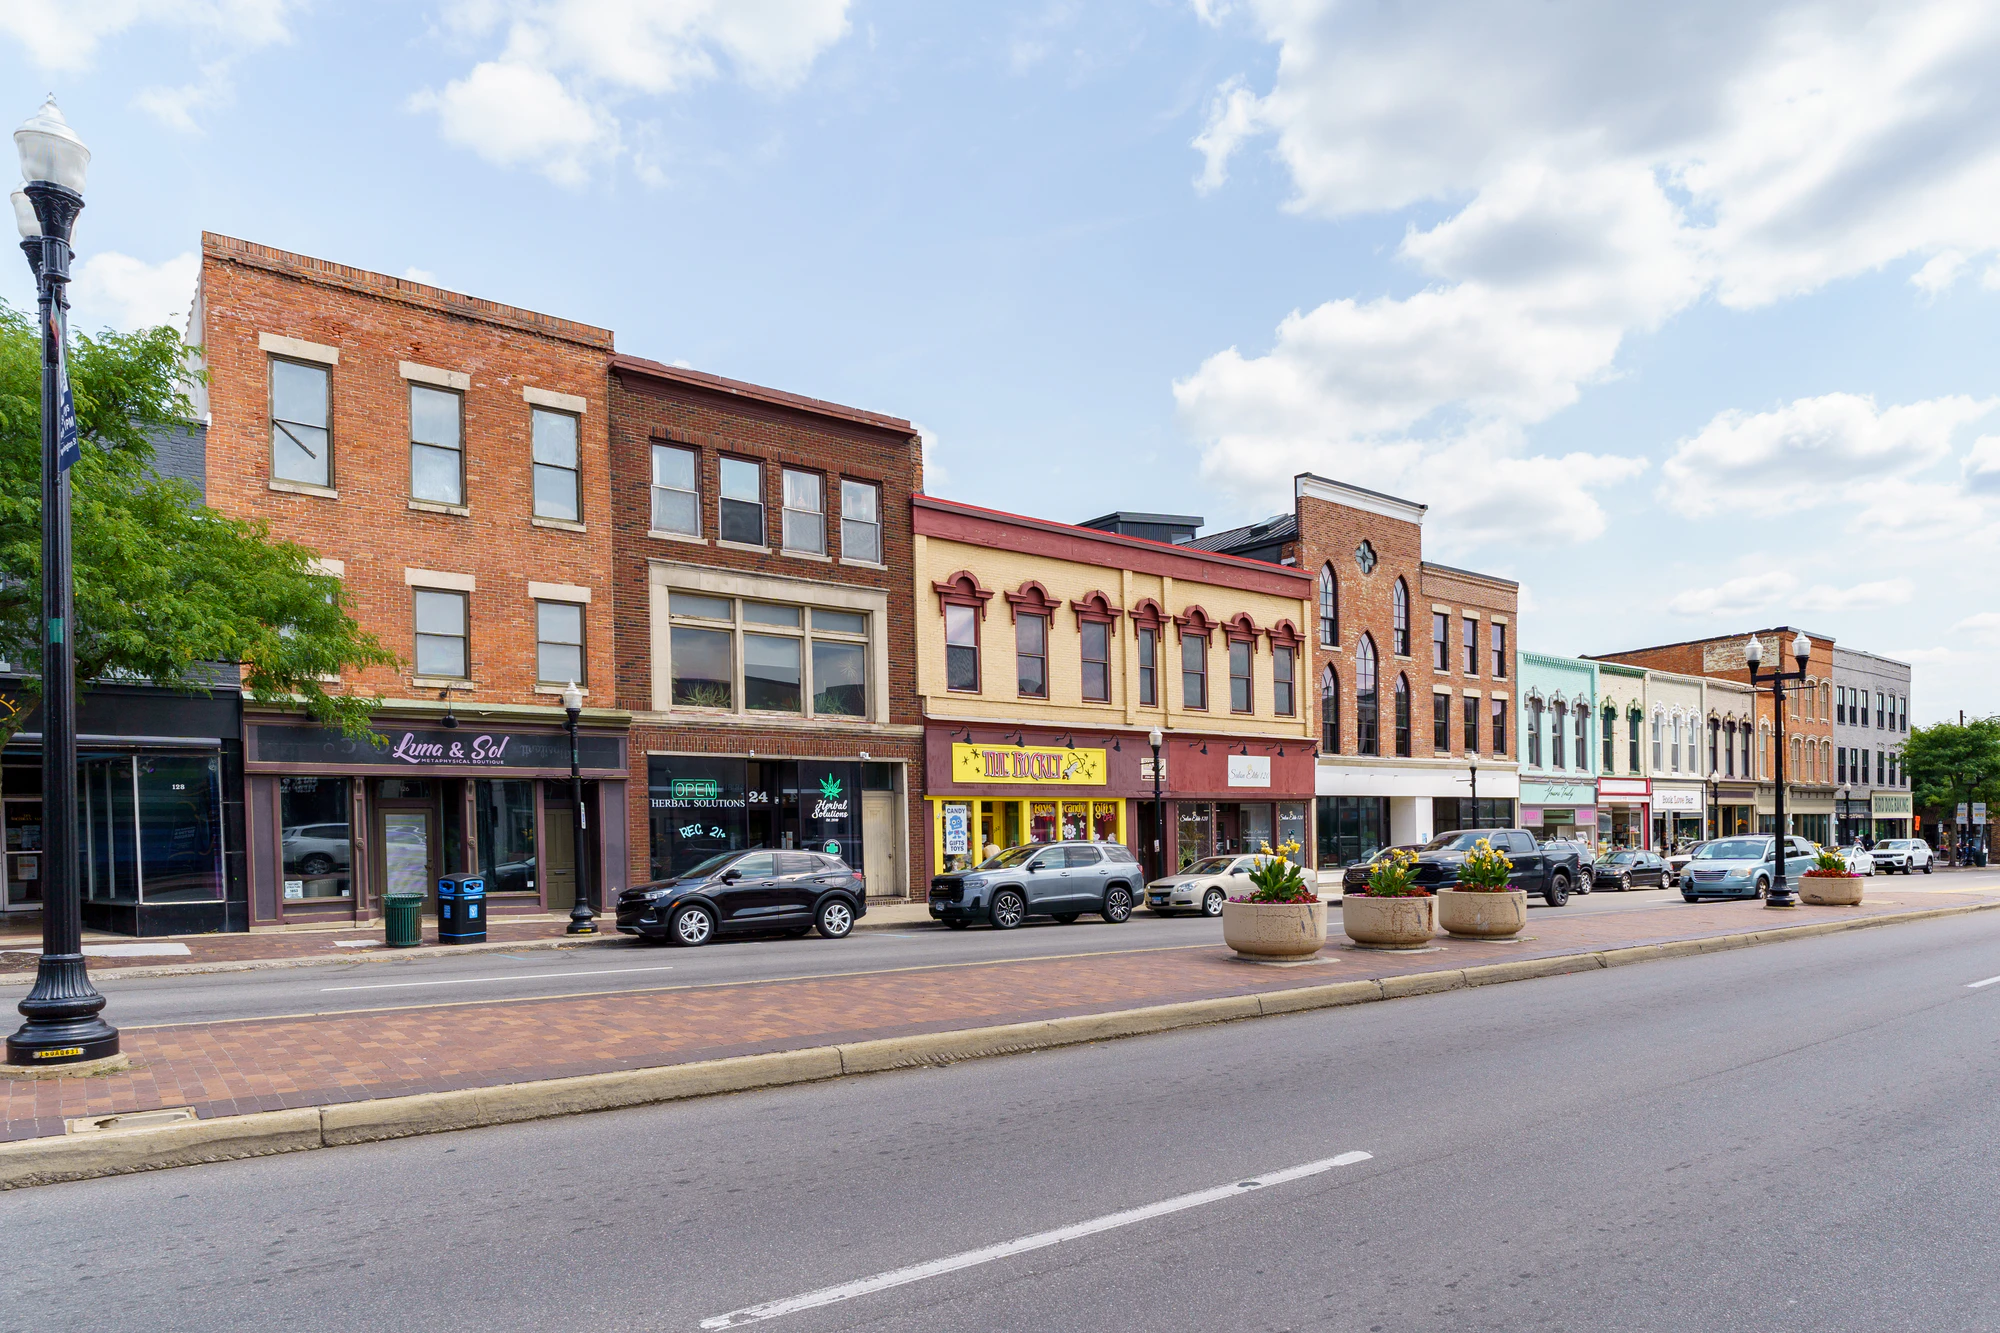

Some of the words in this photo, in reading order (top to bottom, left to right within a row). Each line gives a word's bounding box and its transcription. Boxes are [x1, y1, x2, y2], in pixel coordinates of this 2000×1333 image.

[392, 732, 443, 764] Luna
[449, 741, 464, 758] &
[471, 735, 510, 760] Sol
[982, 750, 1010, 777] THE
[1012, 751, 1063, 781] ROCKET
[675, 782, 715, 797] OPEN
[748, 790, 769, 803] 24
[651, 799, 691, 808] HERBAL
[693, 799, 746, 808] SOLUTIONS
[814, 799, 848, 810] Herbal
[1034, 803, 1053, 816] toys
[1064, 803, 1086, 818] candy
[811, 808, 849, 819] Solutions
[1095, 803, 1113, 819] gifts
